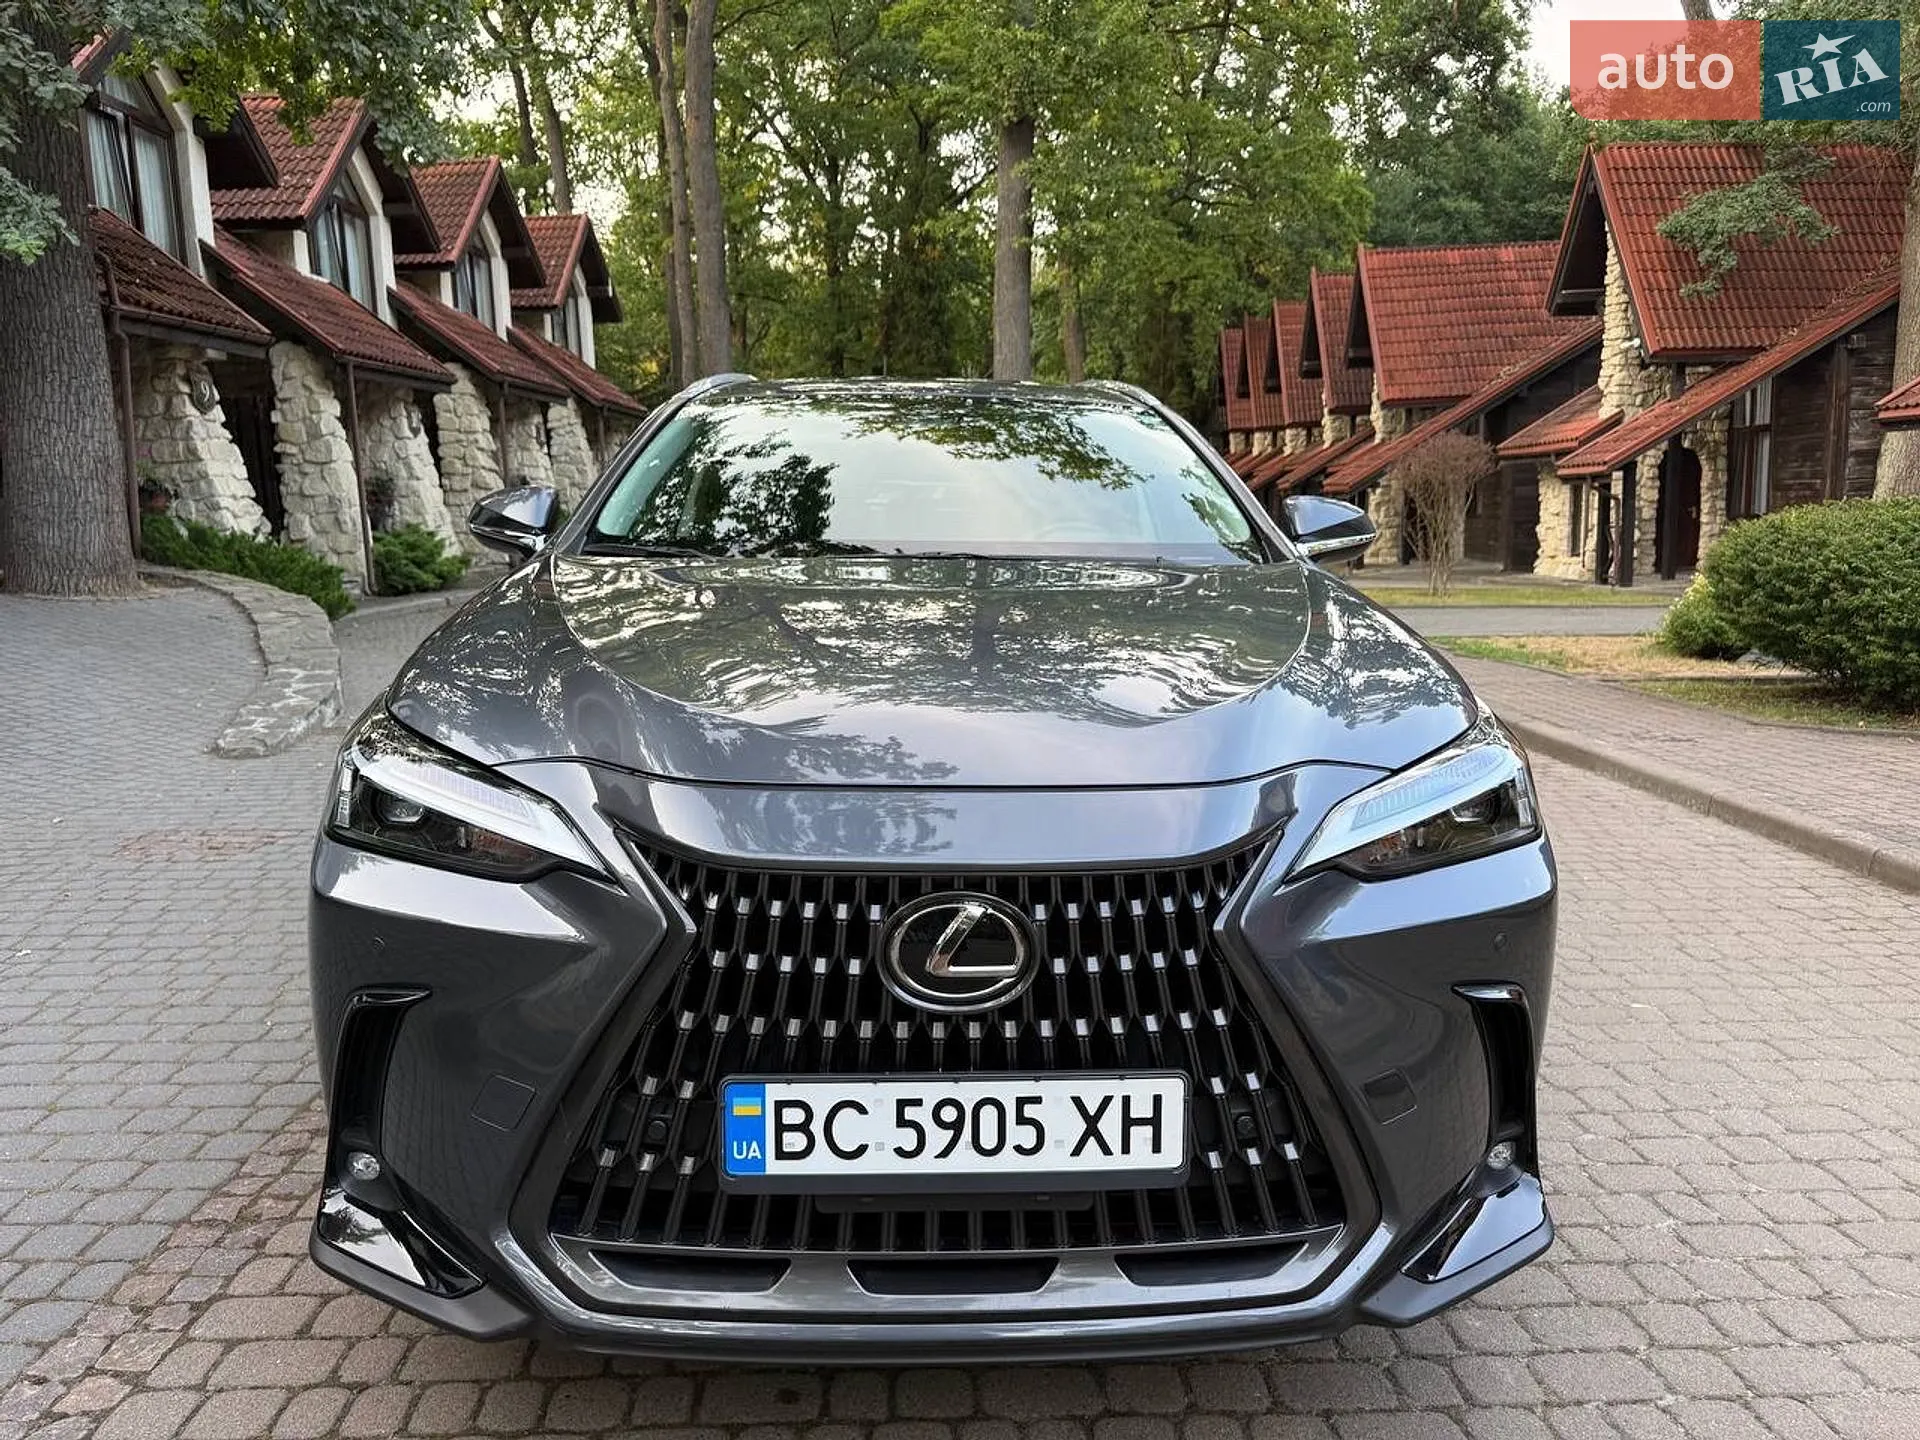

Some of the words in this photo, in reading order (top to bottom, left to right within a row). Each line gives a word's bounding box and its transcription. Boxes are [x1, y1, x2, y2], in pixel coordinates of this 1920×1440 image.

[773, 1099, 870, 1161] BC
[892, 1095, 1046, 1160] 5905
[1069, 1093, 1163, 1157] XH
[732, 1140, 762, 1160] UA
